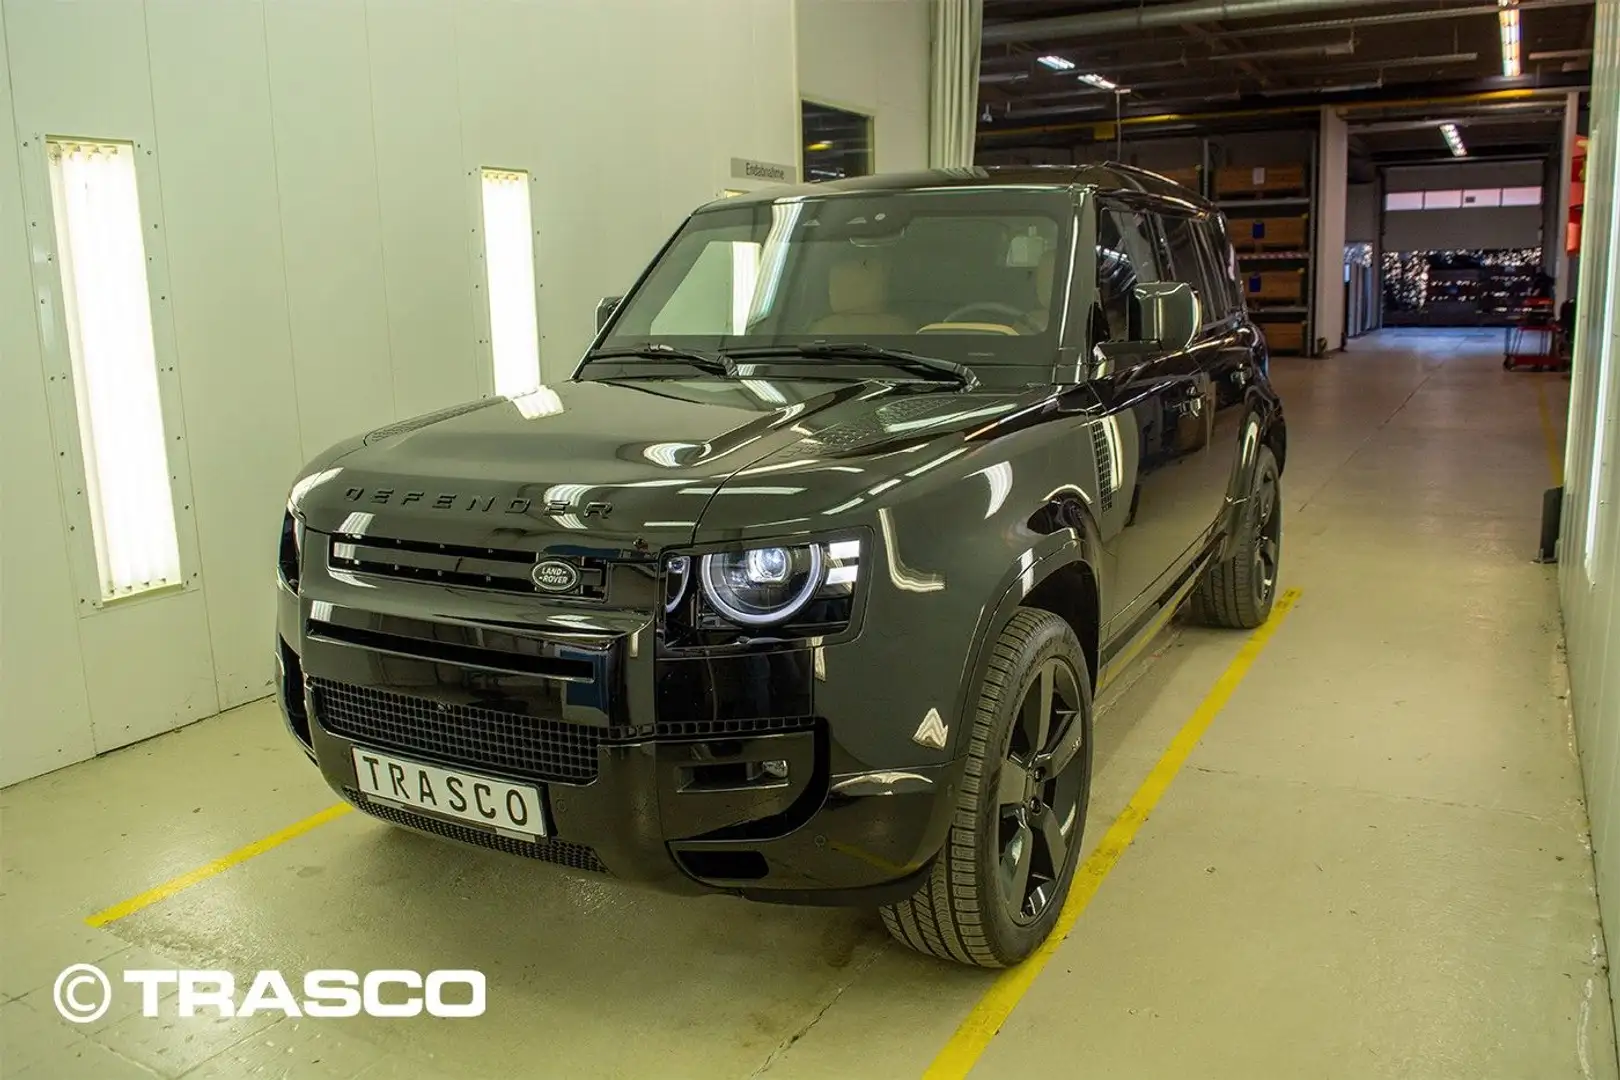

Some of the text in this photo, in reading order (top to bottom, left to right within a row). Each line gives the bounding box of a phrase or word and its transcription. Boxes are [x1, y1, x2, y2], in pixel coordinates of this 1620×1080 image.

[345, 487, 613, 519] DEFENDER
[541, 567, 563, 576] LAND
[542, 575, 568, 584] ROVER
[362, 755, 528, 826] TRASCO
